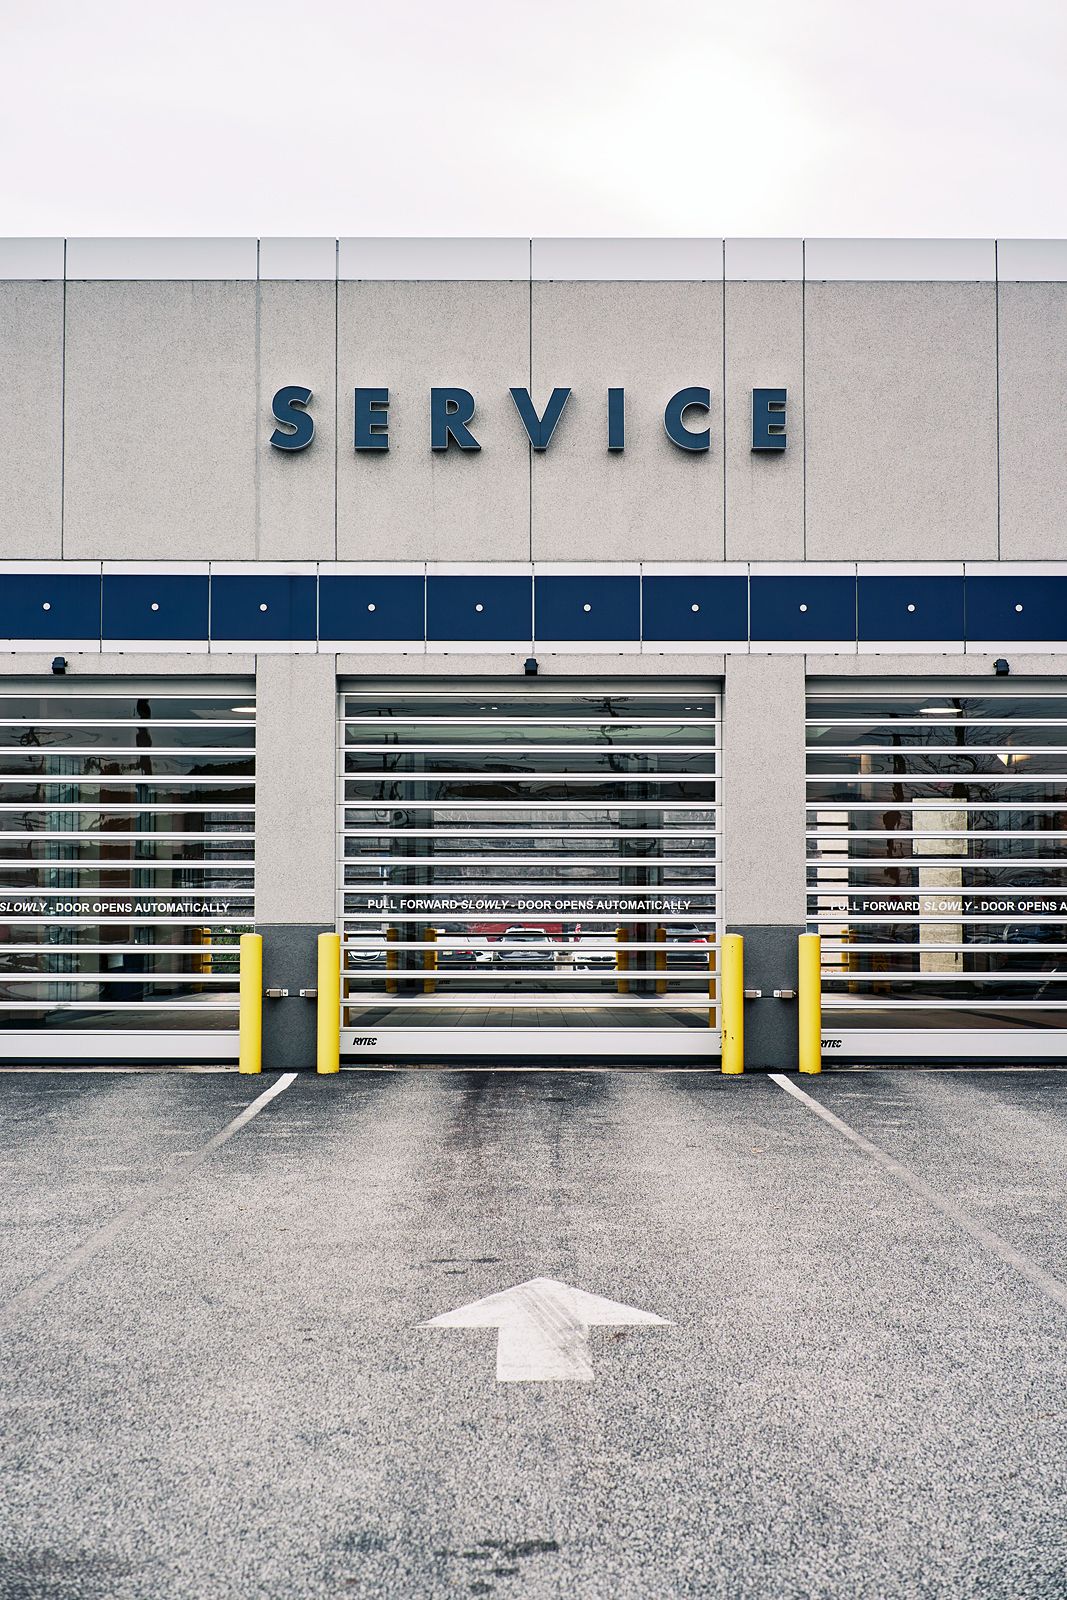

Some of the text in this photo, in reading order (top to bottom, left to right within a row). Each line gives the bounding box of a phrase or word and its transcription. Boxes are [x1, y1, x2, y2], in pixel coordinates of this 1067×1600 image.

[269, 385, 788, 451] SERVICE
[0, 902, 47, 912] SLOWLY
[56, 903, 90, 913] DOOR
[93, 903, 132, 913] OPENS
[134, 903, 230, 913] AUTOMATICALLY
[367, 900, 397, 909] PULL
[400, 900, 458, 909] FORWARD
[462, 900, 509, 910] SLOWLY
[518, 900, 551, 910] DOOR
[554, 900, 595, 910] OPENS
[596, 900, 692, 910] AUTOMATICALLY
[831, 901, 859, 911] PULL
[863, 901, 920, 911] FORWARD
[924, 901, 972, 911] SLOWLY
[981, 902, 1014, 911] DOOR
[1017, 902, 1057, 911] OPENS
[352, 1037, 378, 1046] RYTEC
